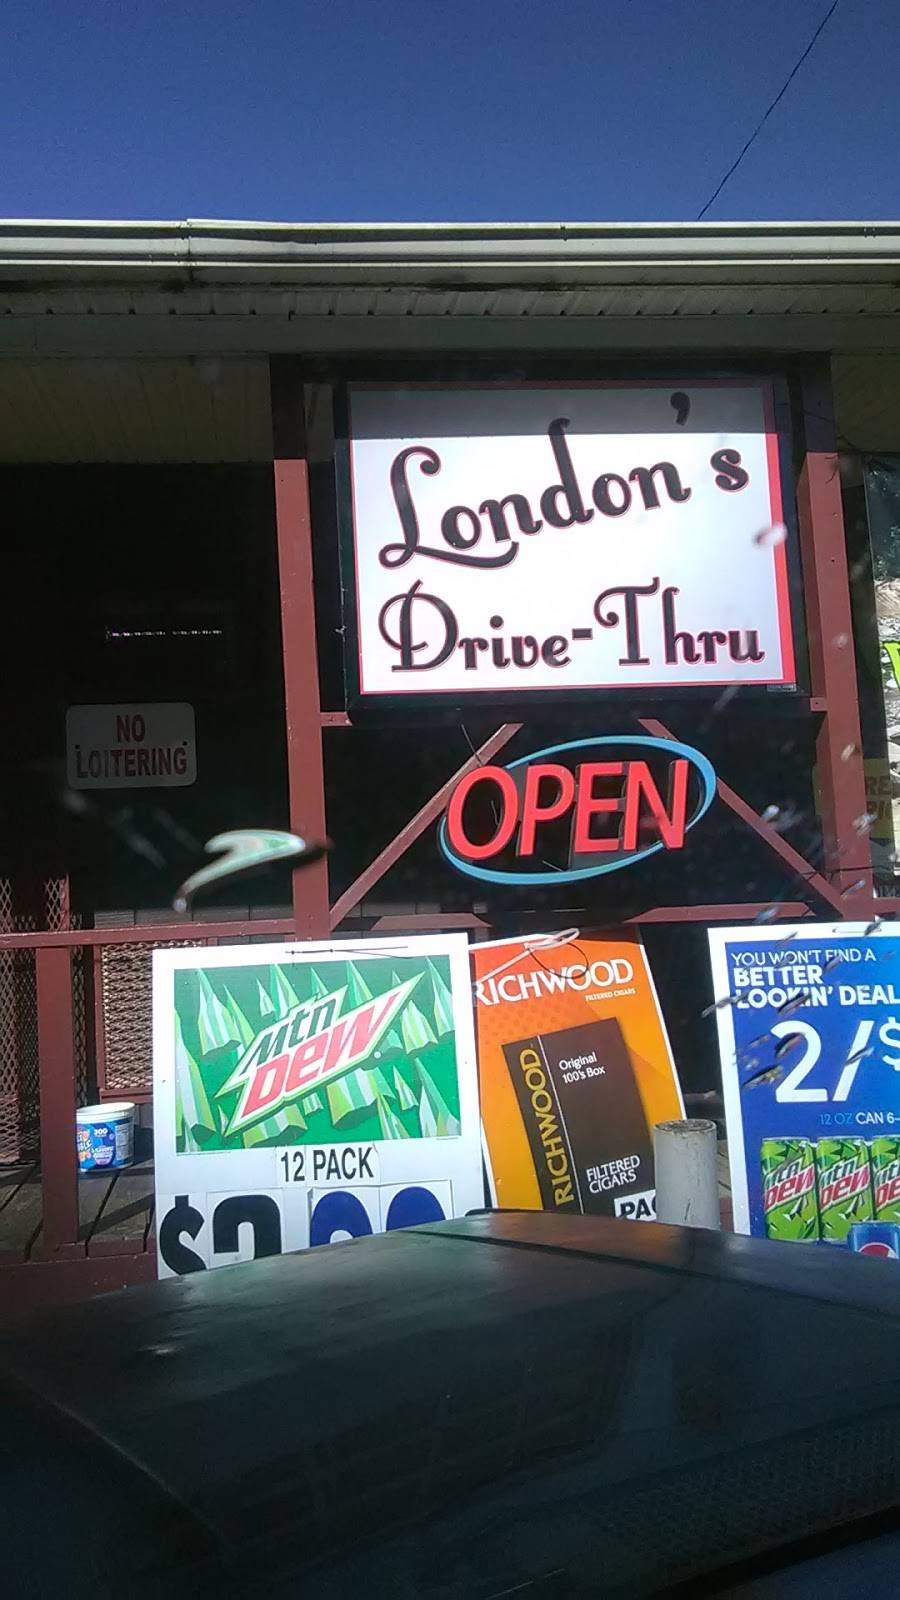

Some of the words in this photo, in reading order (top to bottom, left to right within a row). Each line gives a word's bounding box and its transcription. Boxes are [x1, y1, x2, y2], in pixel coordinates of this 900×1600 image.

[378, 391, 750, 570] London's
[378, 577, 766, 673] Drive-Thru
[115, 714, 146, 743] NO
[75, 747, 187, 779] LOITERING
[446, 759, 690, 861] OPEN
[731, 951, 766, 966] YOU
[768, 949, 821, 965] WON'T
[825, 948, 861, 964] FIND
[865, 948, 877, 962] A
[733, 964, 824, 987] BETTER
[585, 990, 613, 1001] FILTERED
[614, 988, 637, 998] CIGARS
[558, 1051, 598, 1071] Original
[562, 1069, 587, 1084] 100's
[586, 1066, 606, 1079] Box
[519, 1048, 575, 1206] RICHWOOD
[820, 1113, 832, 1125] 12
[855, 1111, 884, 1124] CAN
[280, 1151, 306, 1182] 12
[312, 1147, 374, 1181] PACK
[586, 1155, 641, 1182] FILTERED
[588, 1169, 637, 1194] CIGARS
